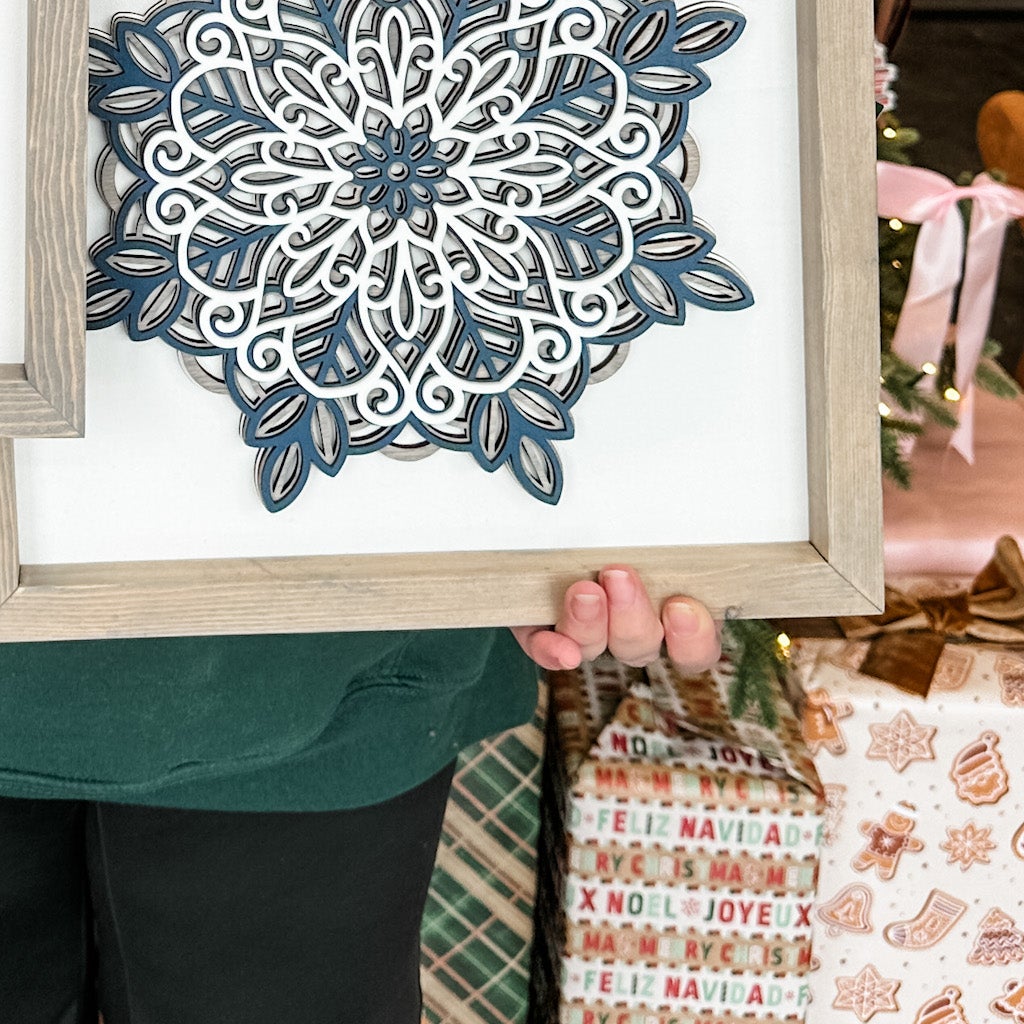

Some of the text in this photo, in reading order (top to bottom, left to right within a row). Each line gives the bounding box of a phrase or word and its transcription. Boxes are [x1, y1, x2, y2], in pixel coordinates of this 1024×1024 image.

[597, 809, 670, 837] FELIZ
[680, 815, 801, 847] NAVIDAD
[607, 890, 676, 918] NOEL
[704, 898, 812, 926] JOYEUX
[583, 969, 656, 996] FELIZ
[664, 976, 783, 1006] NAVIDAD
